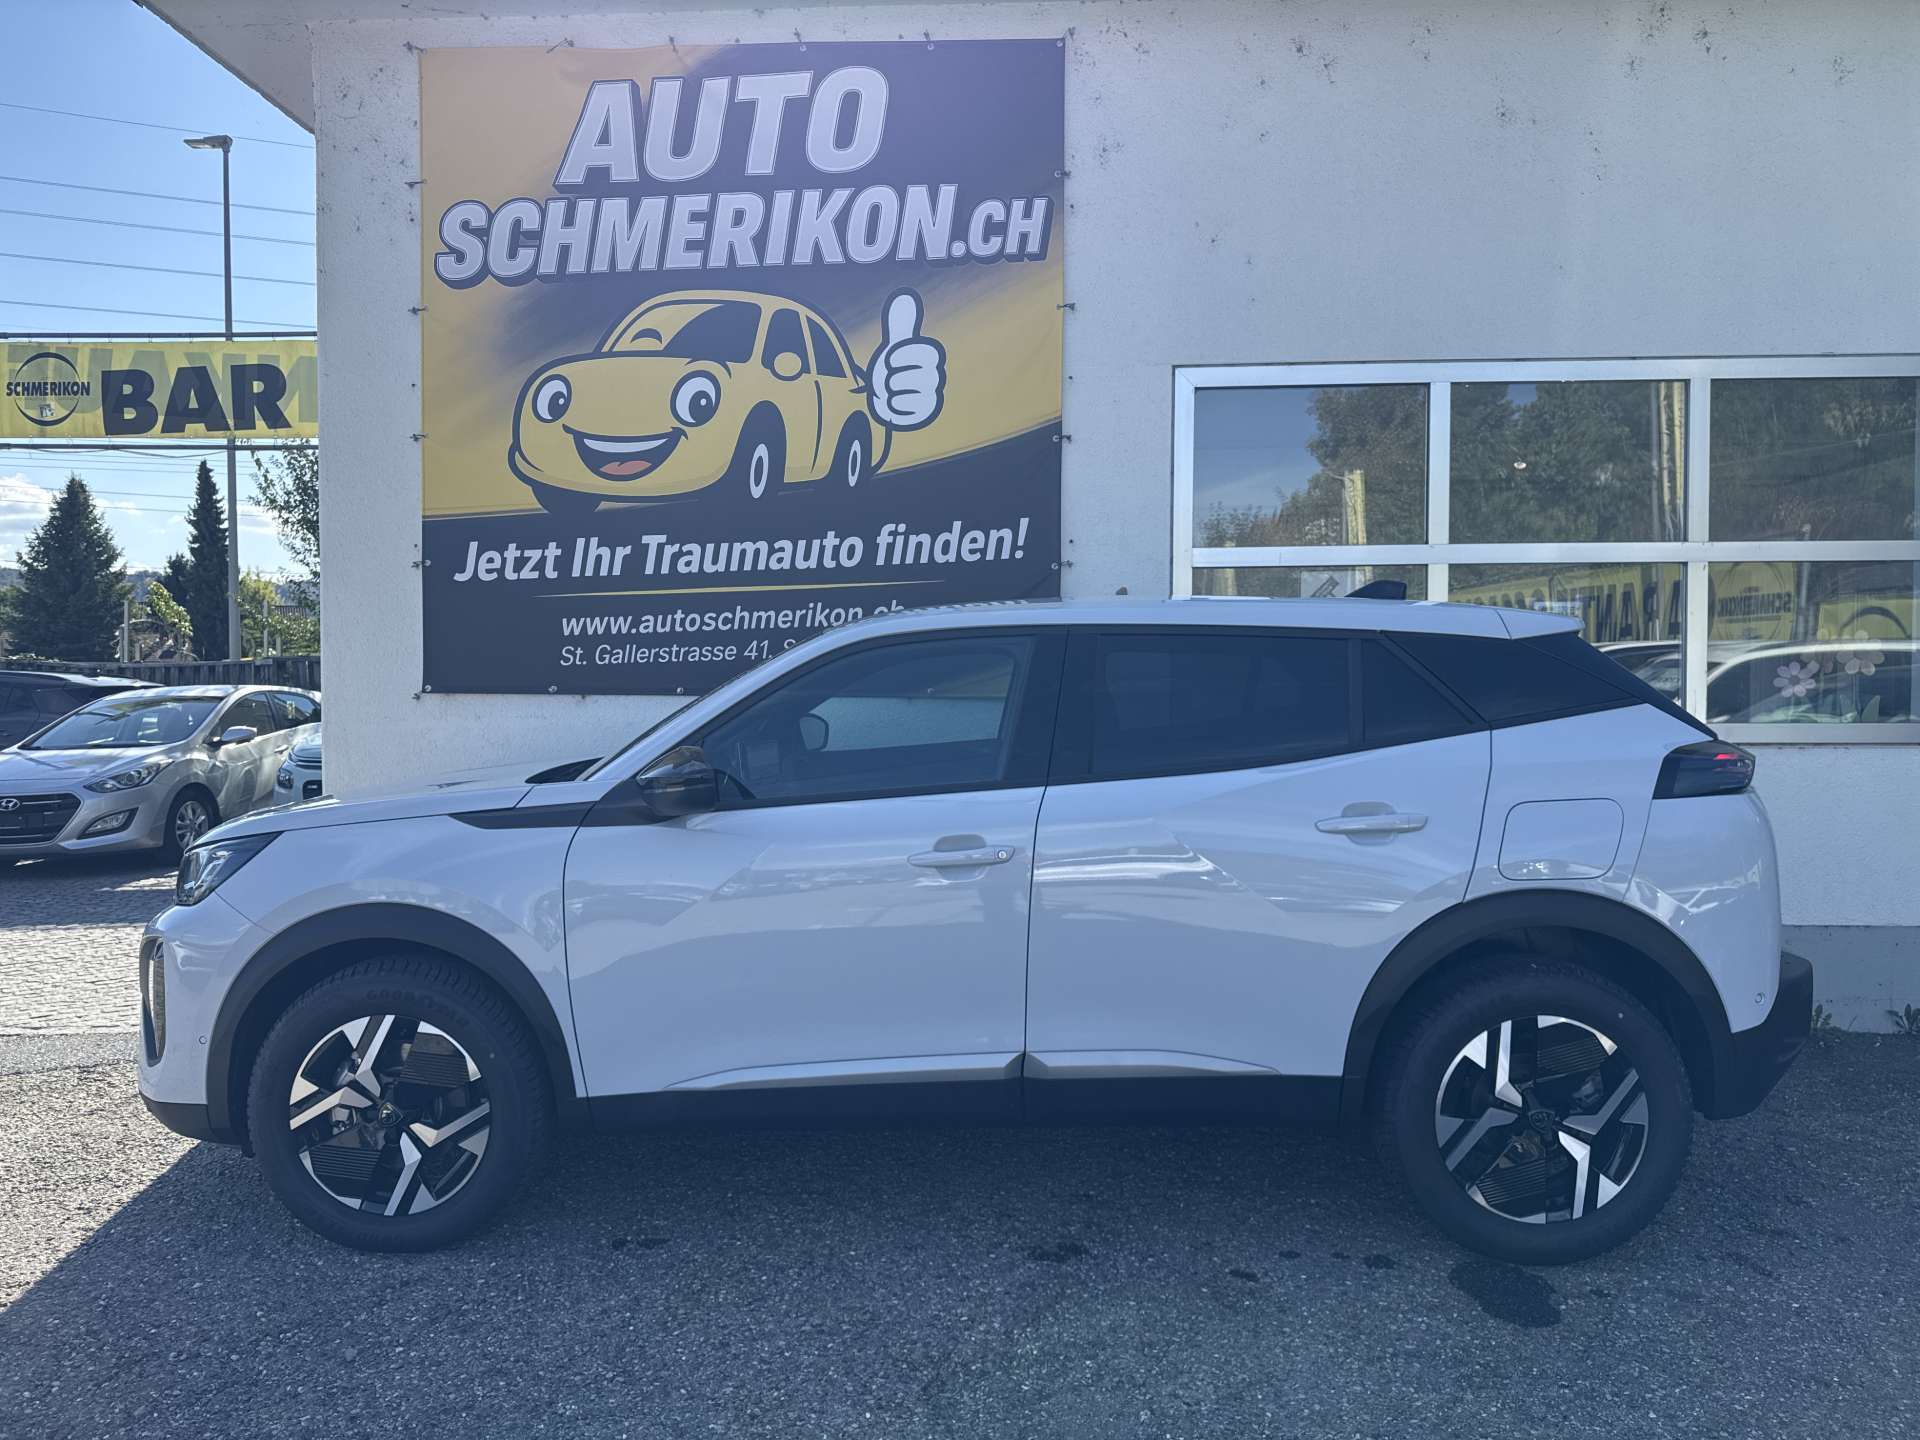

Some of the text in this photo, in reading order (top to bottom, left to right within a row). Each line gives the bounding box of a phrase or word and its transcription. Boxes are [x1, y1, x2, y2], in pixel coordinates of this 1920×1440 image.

[554, 65, 890, 185] AUTO
[434, 184, 1052, 287] SCHMERIKON.CH
[6, 381, 91, 397] SCHMERIKON
[101, 363, 293, 436] BAR
[453, 517, 1030, 582] Jetzt Ihr Traumauto finden!
[561, 600, 905, 636] www.autoschmerikonh
[560, 646, 588, 666] St.
[595, 644, 737, 666] Gallerstrasse
